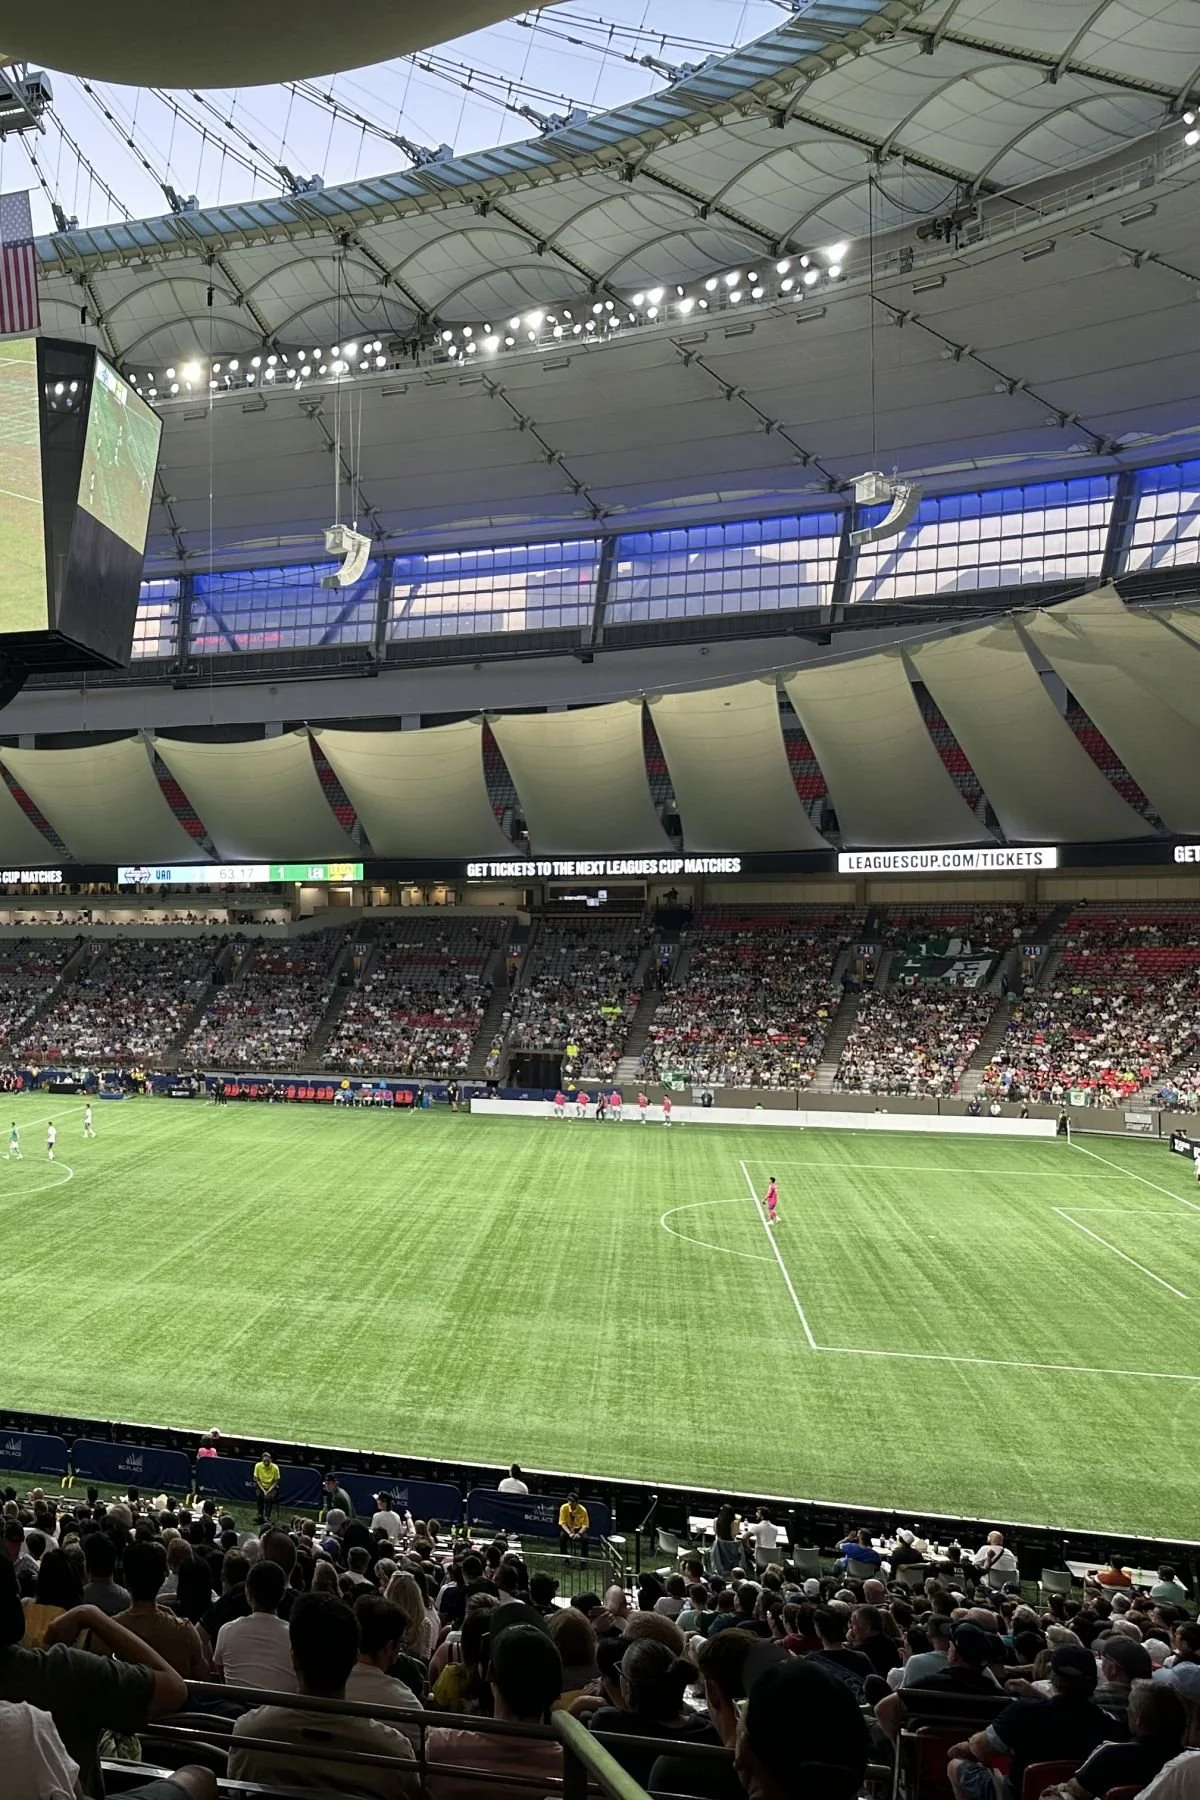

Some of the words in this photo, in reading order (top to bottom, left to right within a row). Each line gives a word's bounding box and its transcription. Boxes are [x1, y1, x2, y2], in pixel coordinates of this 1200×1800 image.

[848, 851, 1043, 869] LEAGUESCUP.COM/TICKETS
[277, 867, 285, 879] 1
[467, 863, 489, 877] GET
[490, 862, 536, 877] TICKETS
[537, 862, 550, 876] TO
[551, 861, 575, 876] THE
[576, 860, 605, 876] NEXT
[606, 859, 658, 875] LEAGUES
[659, 859, 683, 874] CUP
[684, 858, 741, 873] MATCHES
[2, 871, 20, 884] CUP
[20, 870, 62, 883] MATCHES
[219, 868, 234, 879] 63
[240, 868, 254, 879] 17
[660, 945, 672, 953] 217
[859, 946, 874, 954] 218
[1025, 946, 1041, 955] 219
